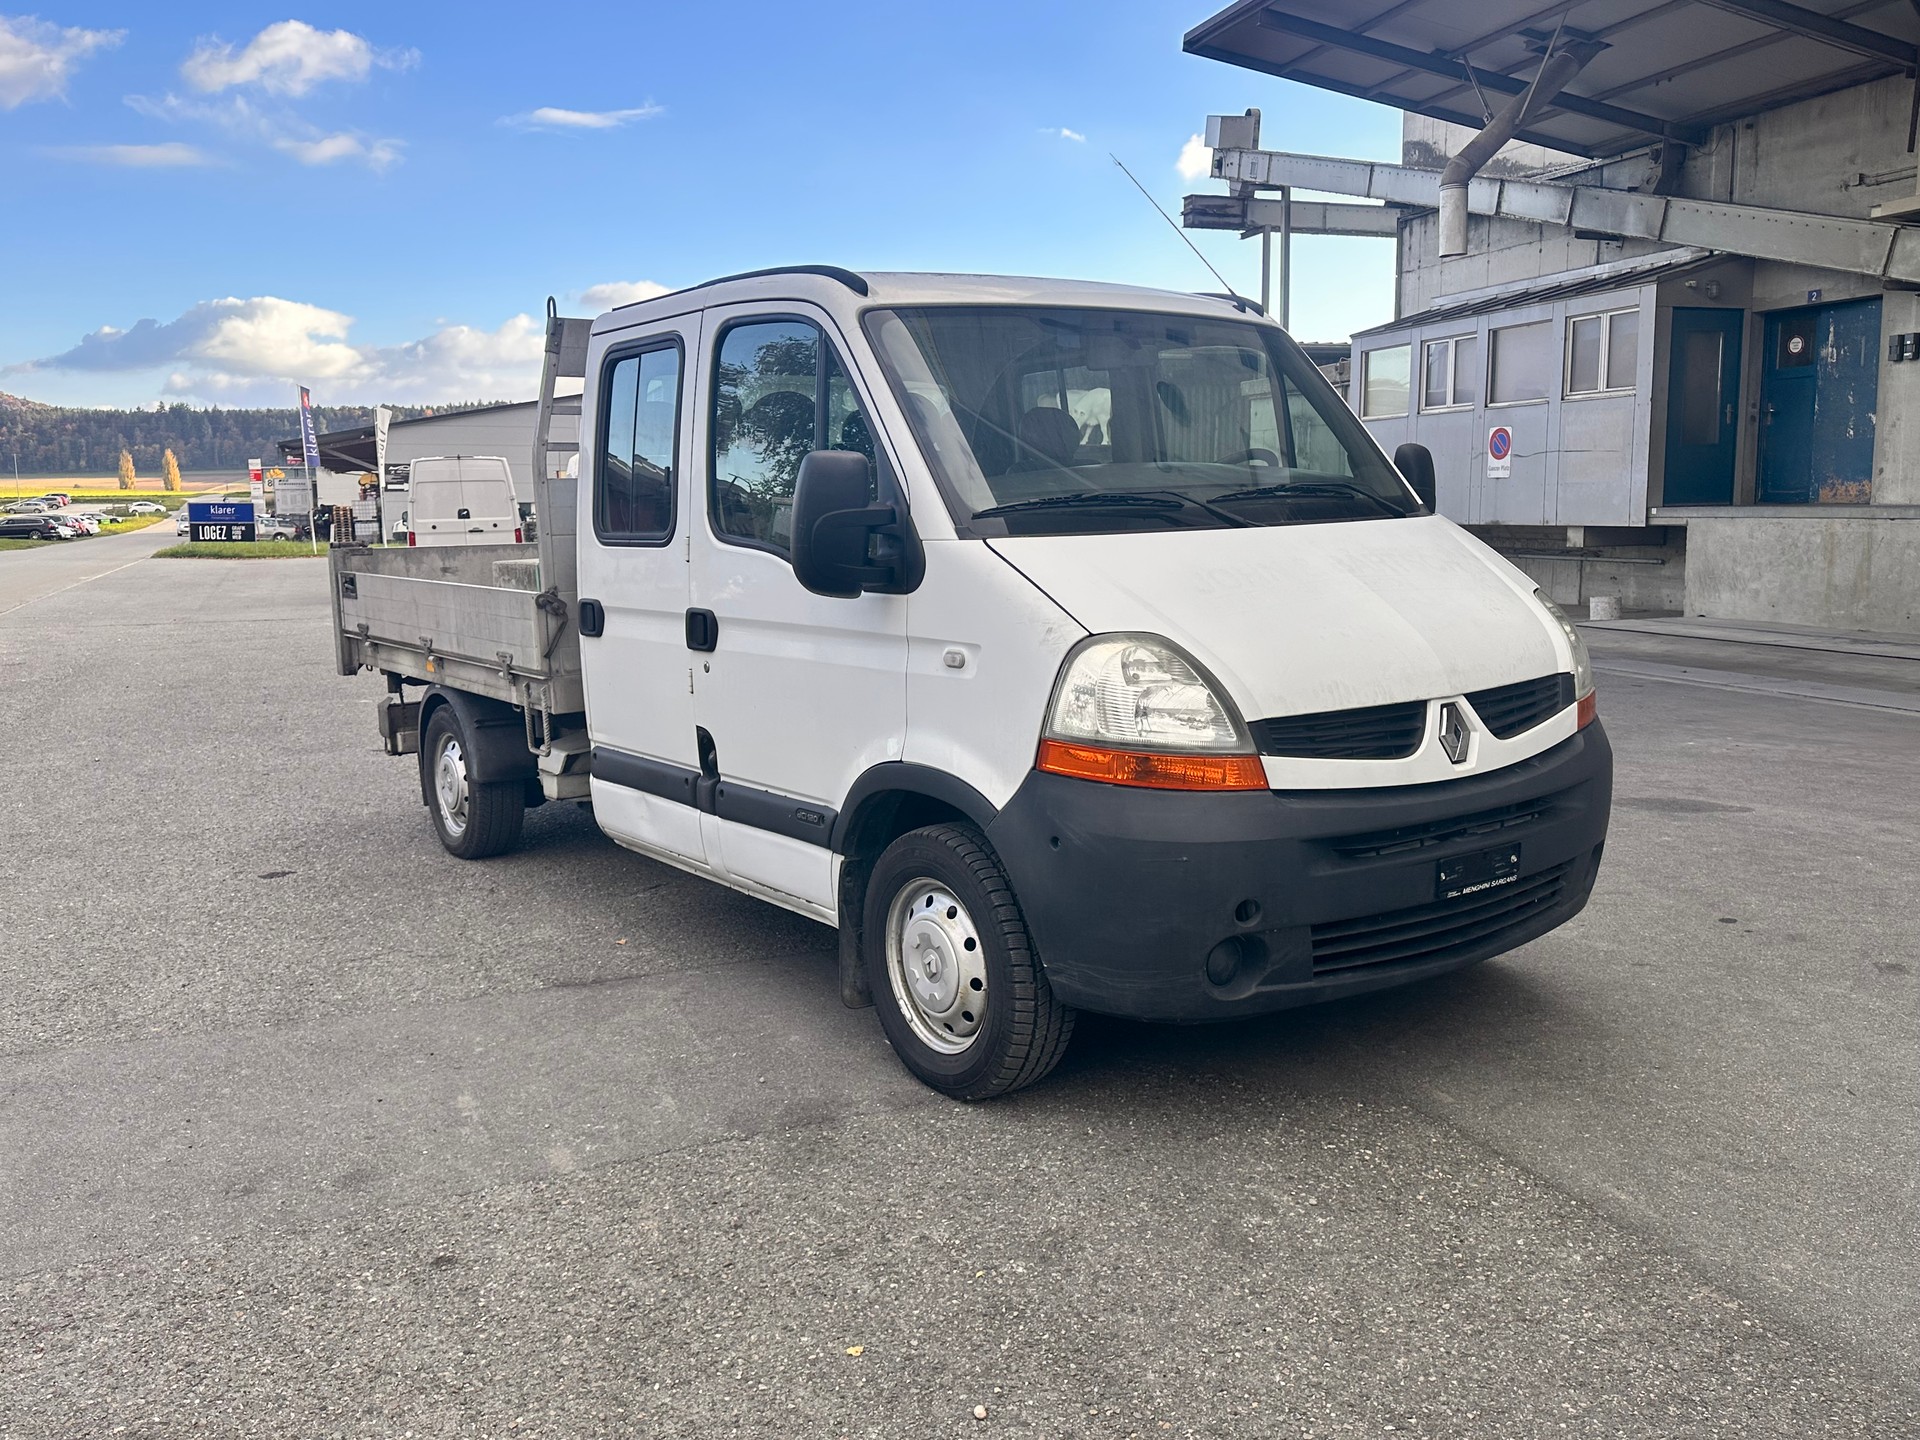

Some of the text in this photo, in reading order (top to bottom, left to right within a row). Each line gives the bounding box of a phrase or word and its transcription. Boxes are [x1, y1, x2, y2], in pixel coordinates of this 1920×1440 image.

[1811, 291, 1817, 301] 2
[305, 411, 318, 457] klarer
[210, 505, 236, 520] klarer
[199, 525, 227, 540] LOGEZ
[1462, 874, 1518, 894] MENGHINI SARGANS
